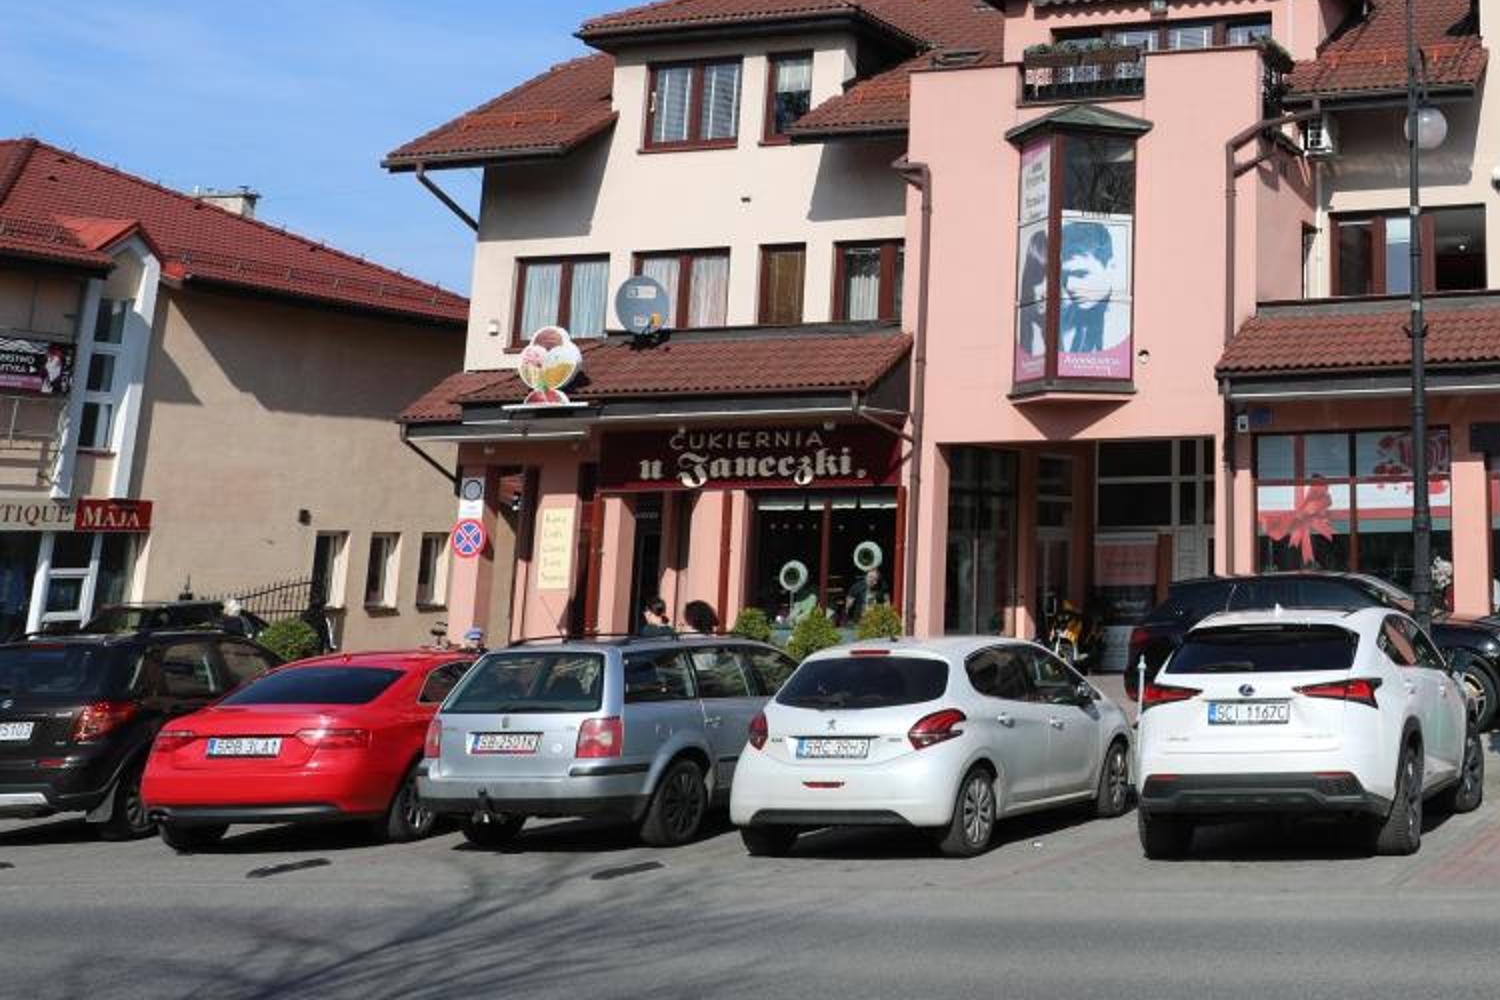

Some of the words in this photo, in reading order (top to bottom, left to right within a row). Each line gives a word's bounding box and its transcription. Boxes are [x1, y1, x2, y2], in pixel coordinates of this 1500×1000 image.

[670, 430, 823, 450] CUKIERNIA
[82, 507, 140, 527] MAJA
[1218, 705, 1240, 721] SCI
[1247, 705, 1286, 720] 1167C
